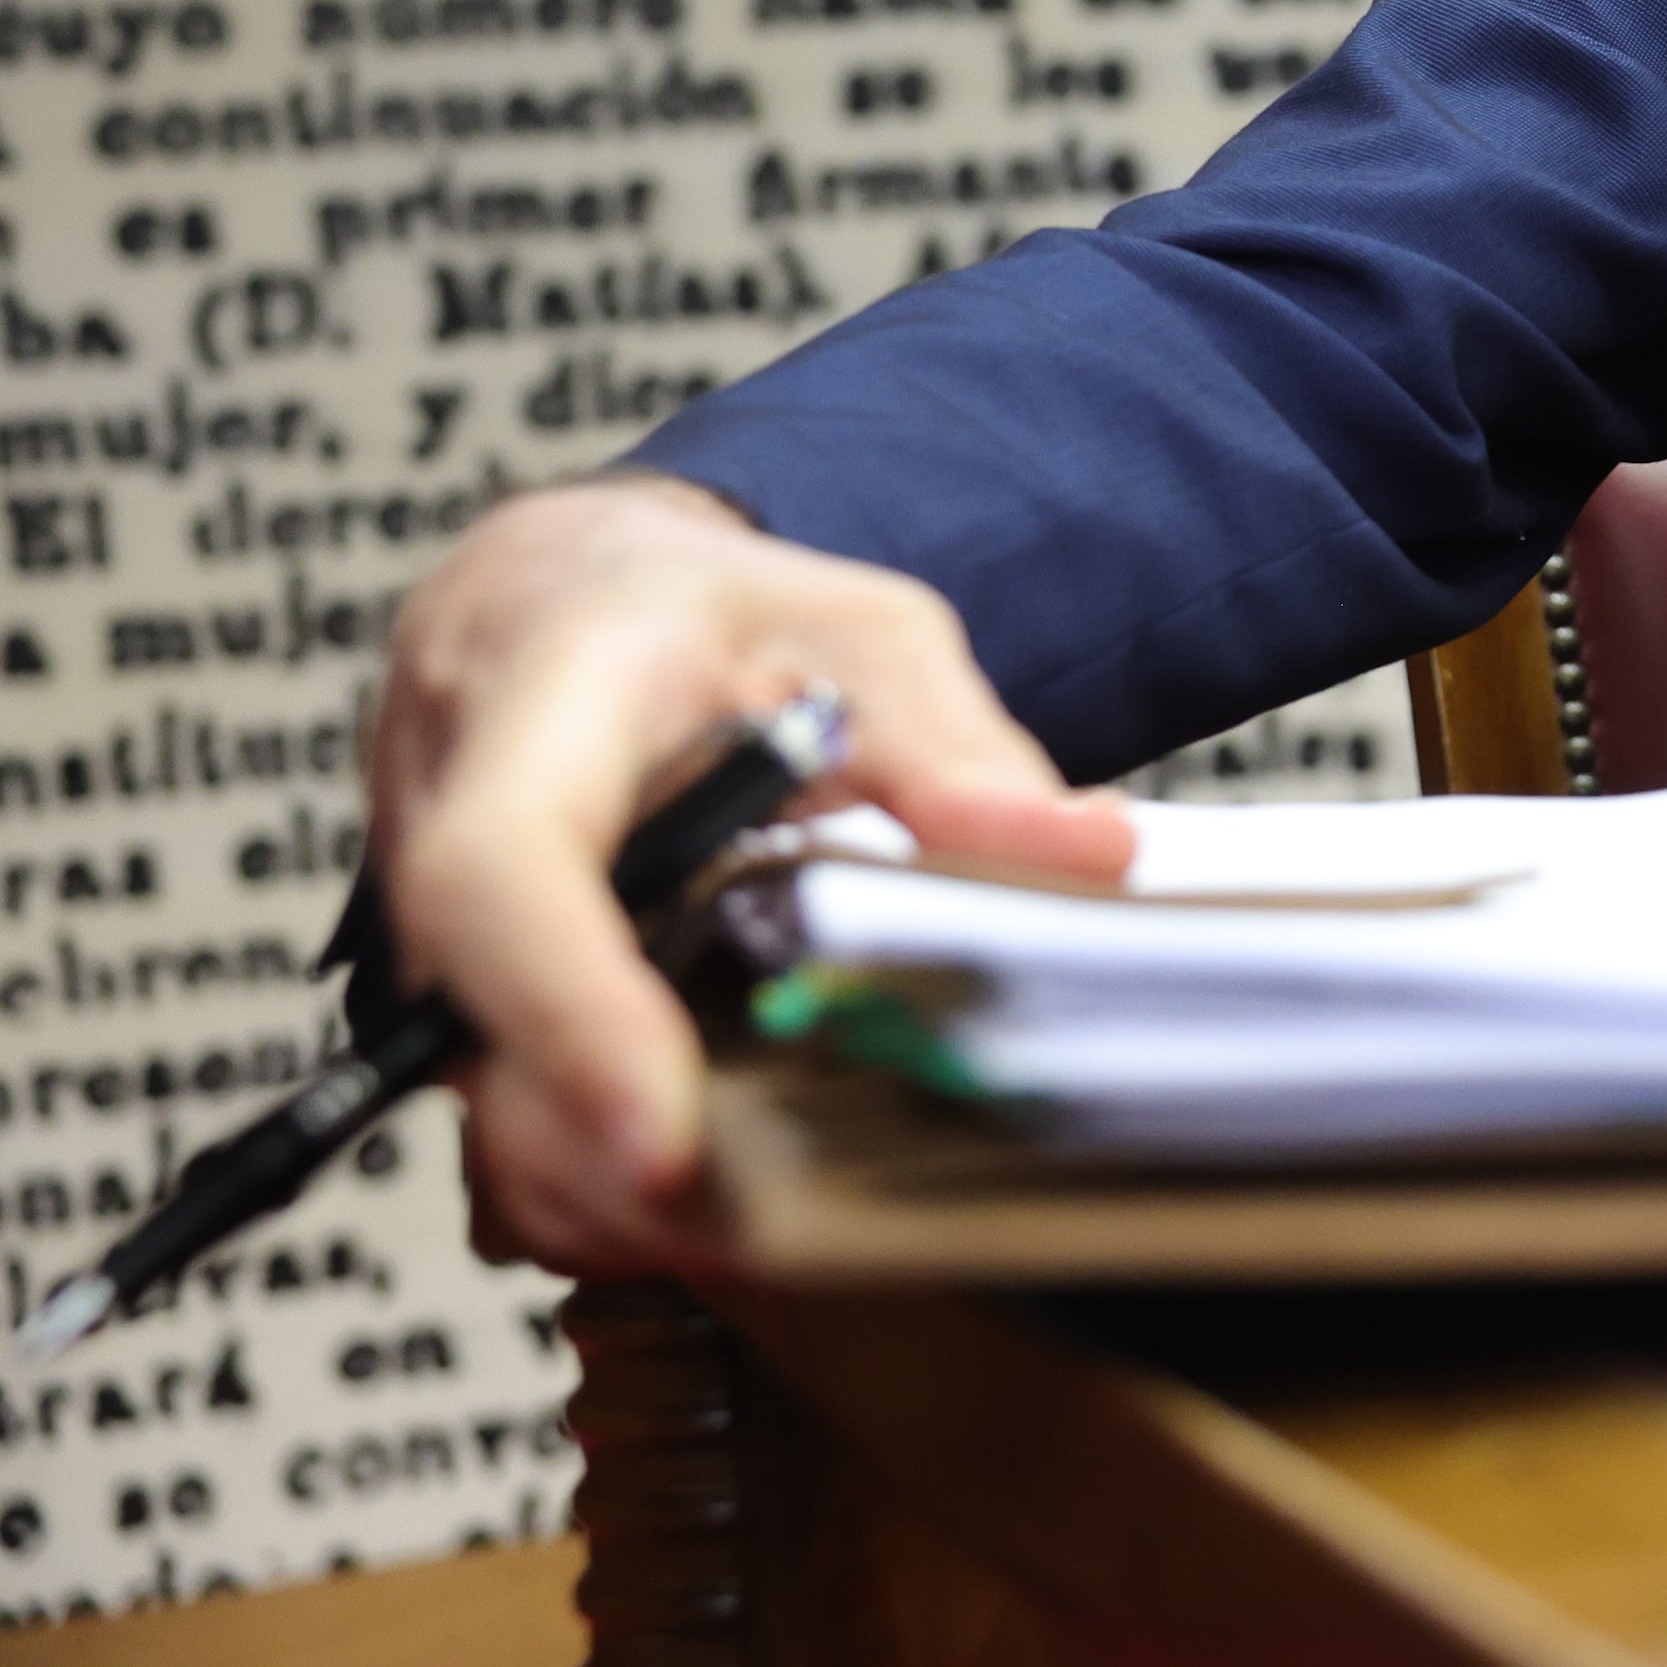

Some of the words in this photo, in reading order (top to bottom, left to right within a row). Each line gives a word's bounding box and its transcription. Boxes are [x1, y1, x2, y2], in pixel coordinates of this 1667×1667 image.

[90, 48, 762, 165] continuación
[314, 162, 656, 274] primer
[0, 376, 347, 476] mujer,
[410, 381, 467, 464] y
[8, 490, 110, 573] El
[336, 1327, 456, 1383] en
[115, 1472, 213, 1533] se
